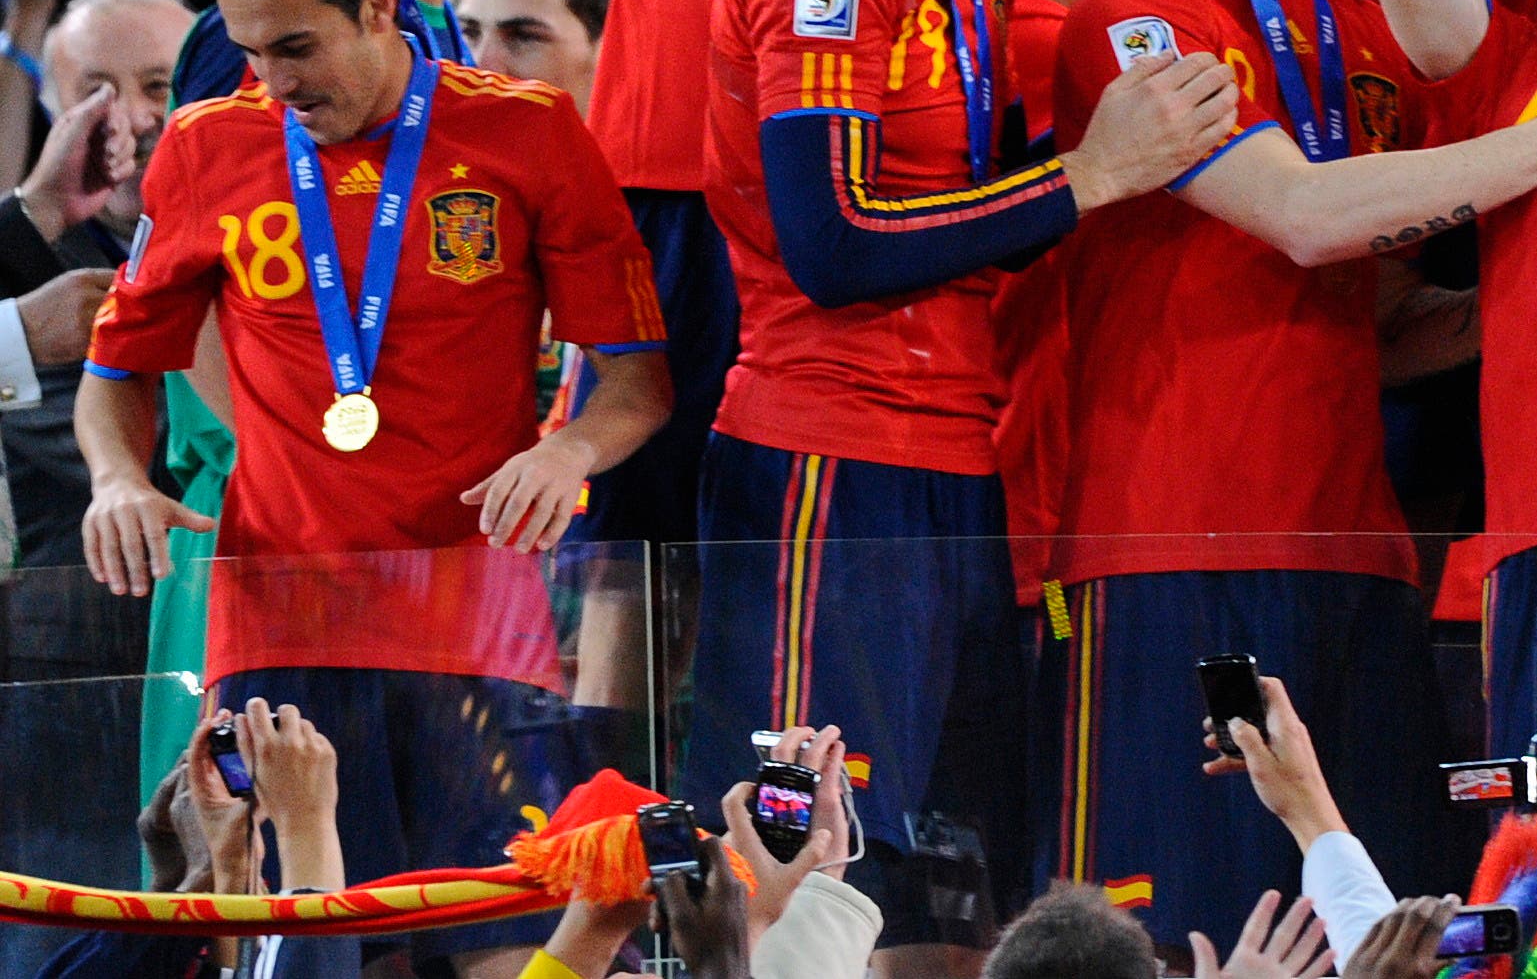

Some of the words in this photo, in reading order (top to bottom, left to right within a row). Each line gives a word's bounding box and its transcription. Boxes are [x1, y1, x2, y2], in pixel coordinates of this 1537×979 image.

[1266, 17, 1288, 52] FIFA
[1320, 15, 1336, 44] FIFA
[959, 44, 974, 82] FIFA
[402, 94, 425, 127] FIFA
[981, 77, 991, 111] FIFA
[1302, 122, 1322, 156] FIFA
[1329, 109, 1344, 141] FIFA
[295, 156, 316, 190] FIFA
[334, 182, 381, 196] adida
[378, 193, 401, 227] FIFA
[218, 201, 306, 299] 18
[314, 253, 335, 289] FIFA
[360, 295, 382, 329] FIFA
[336, 353, 357, 389] FIFA
